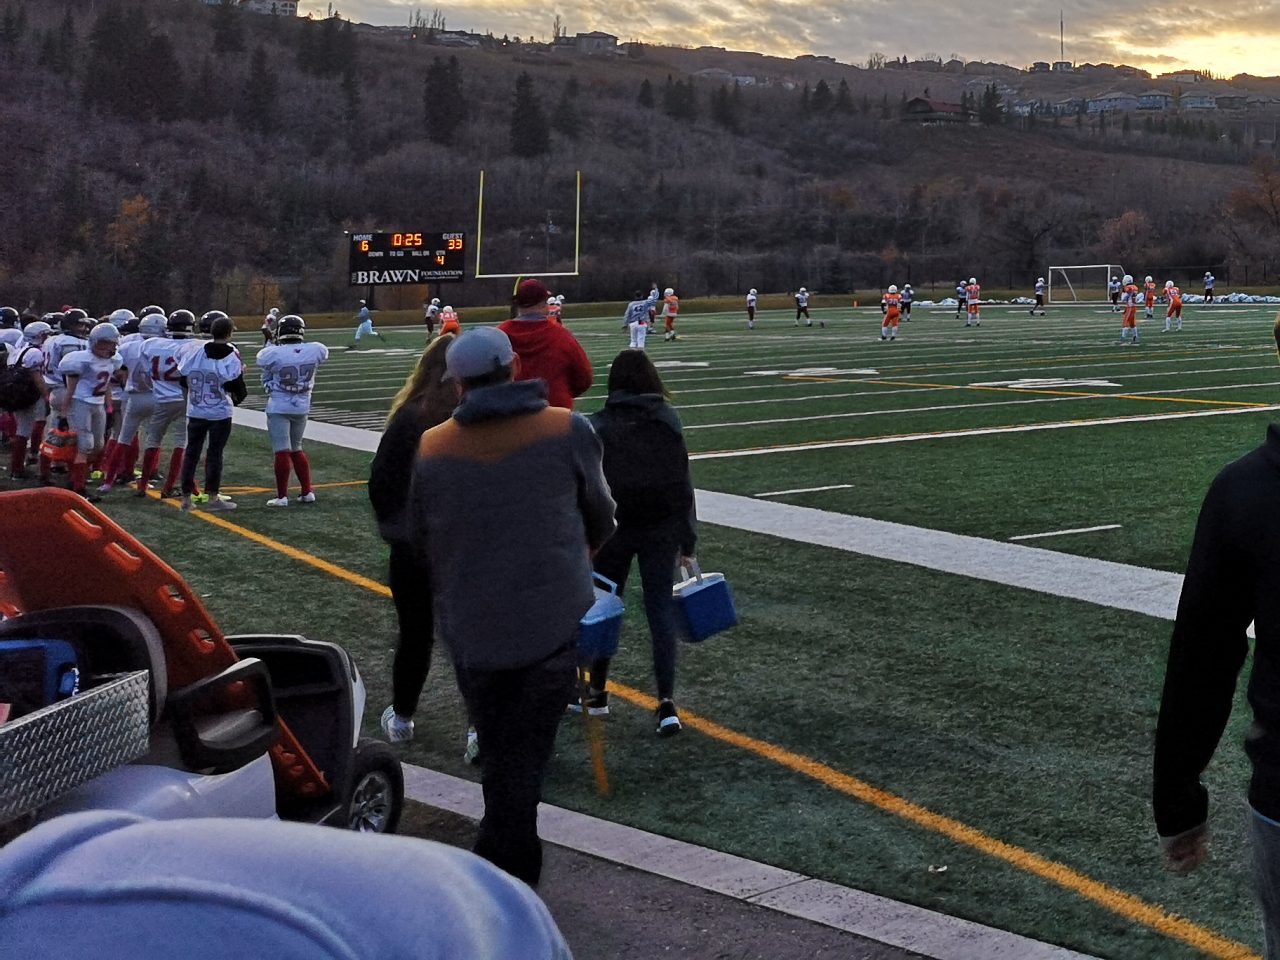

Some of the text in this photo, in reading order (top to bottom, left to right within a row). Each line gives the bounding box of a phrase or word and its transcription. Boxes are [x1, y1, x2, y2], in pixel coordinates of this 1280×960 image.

[361, 241, 369, 251] 6
[393, 234, 422, 246] 0:25
[448, 239, 463, 250] 33
[437, 256, 444, 265] 4
[357, 269, 420, 284] BRAWN
[151, 355, 181, 382] 12
[92, 371, 110, 397] 2
